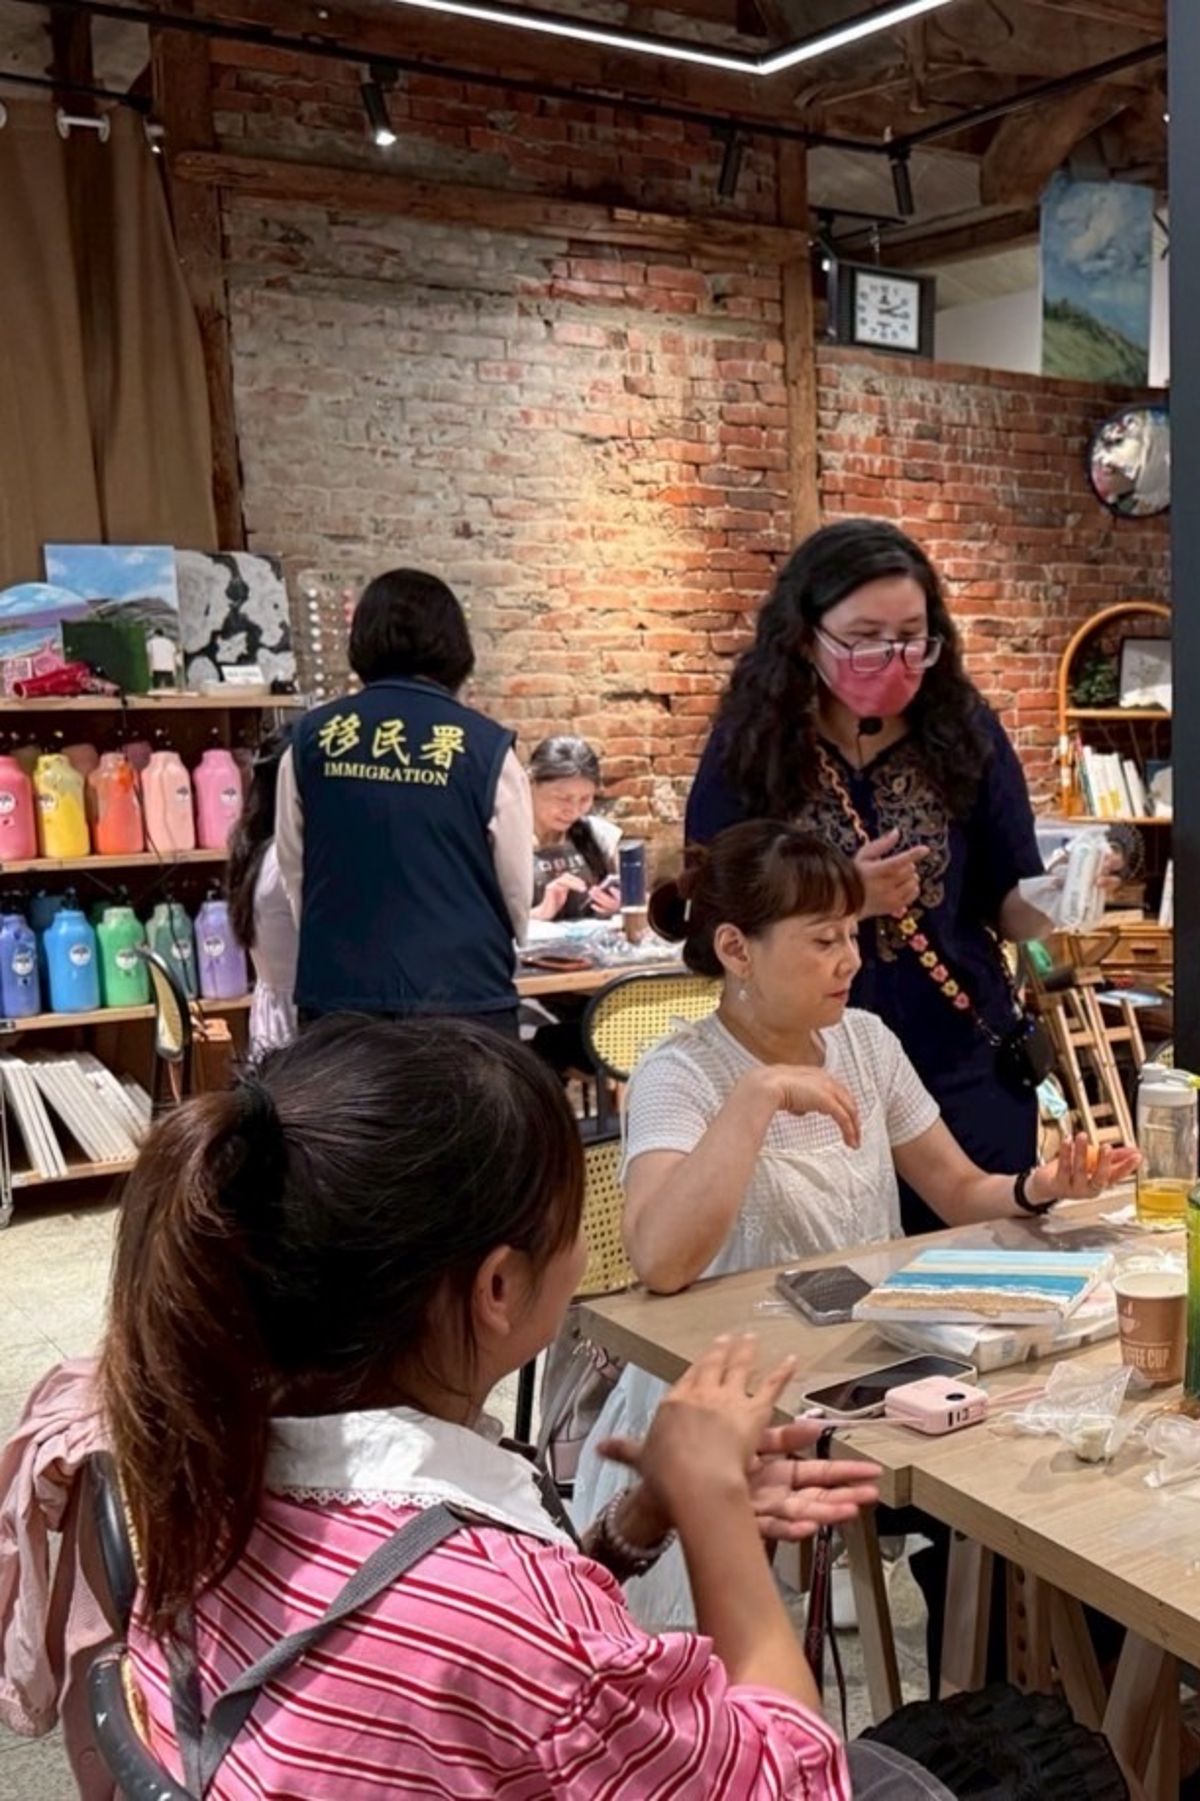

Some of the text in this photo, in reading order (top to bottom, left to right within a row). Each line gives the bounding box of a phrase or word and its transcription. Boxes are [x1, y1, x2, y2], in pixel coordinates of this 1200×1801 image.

[318, 712, 465, 770] 移民署
[324, 761, 450, 787] IMMIGRATION
[1147, 1349, 1170, 1369] CUP
